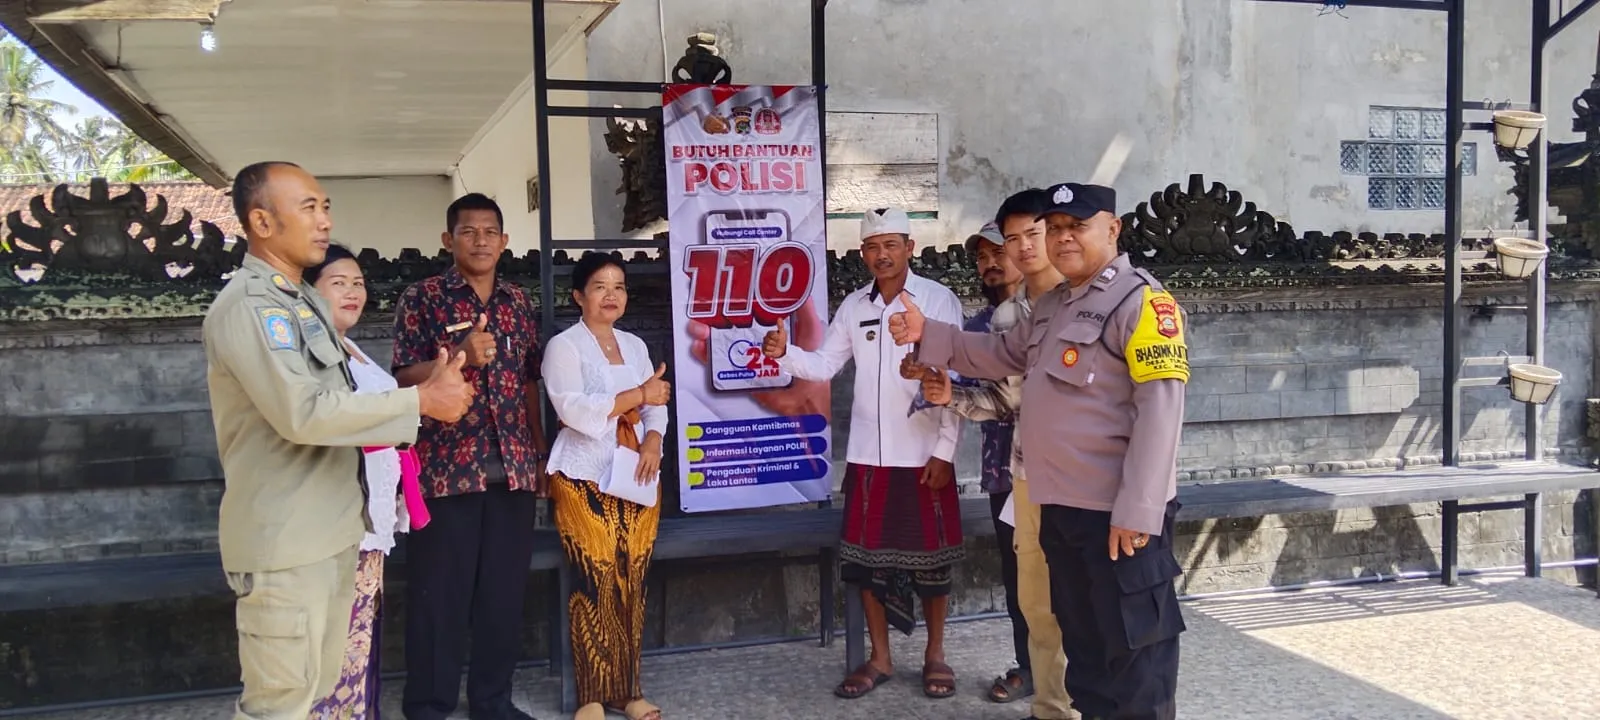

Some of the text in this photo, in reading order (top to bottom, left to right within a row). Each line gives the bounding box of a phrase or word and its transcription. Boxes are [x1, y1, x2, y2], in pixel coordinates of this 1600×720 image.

[672, 144, 813, 159] BUTUH BANTUAN
[684, 161, 807, 194] POLISI
[683, 241, 815, 327] 110
[1076, 310, 1105, 322] POLRI
[757, 369, 779, 378] JAM
[705, 421, 801, 436] Gangguan Kamtibmas
[706, 442, 808, 457] Informasi Layanan POLRI
[707, 462, 800, 477] Pengaduan Kriminal &
[707, 477, 758, 488] Laka Lantas
